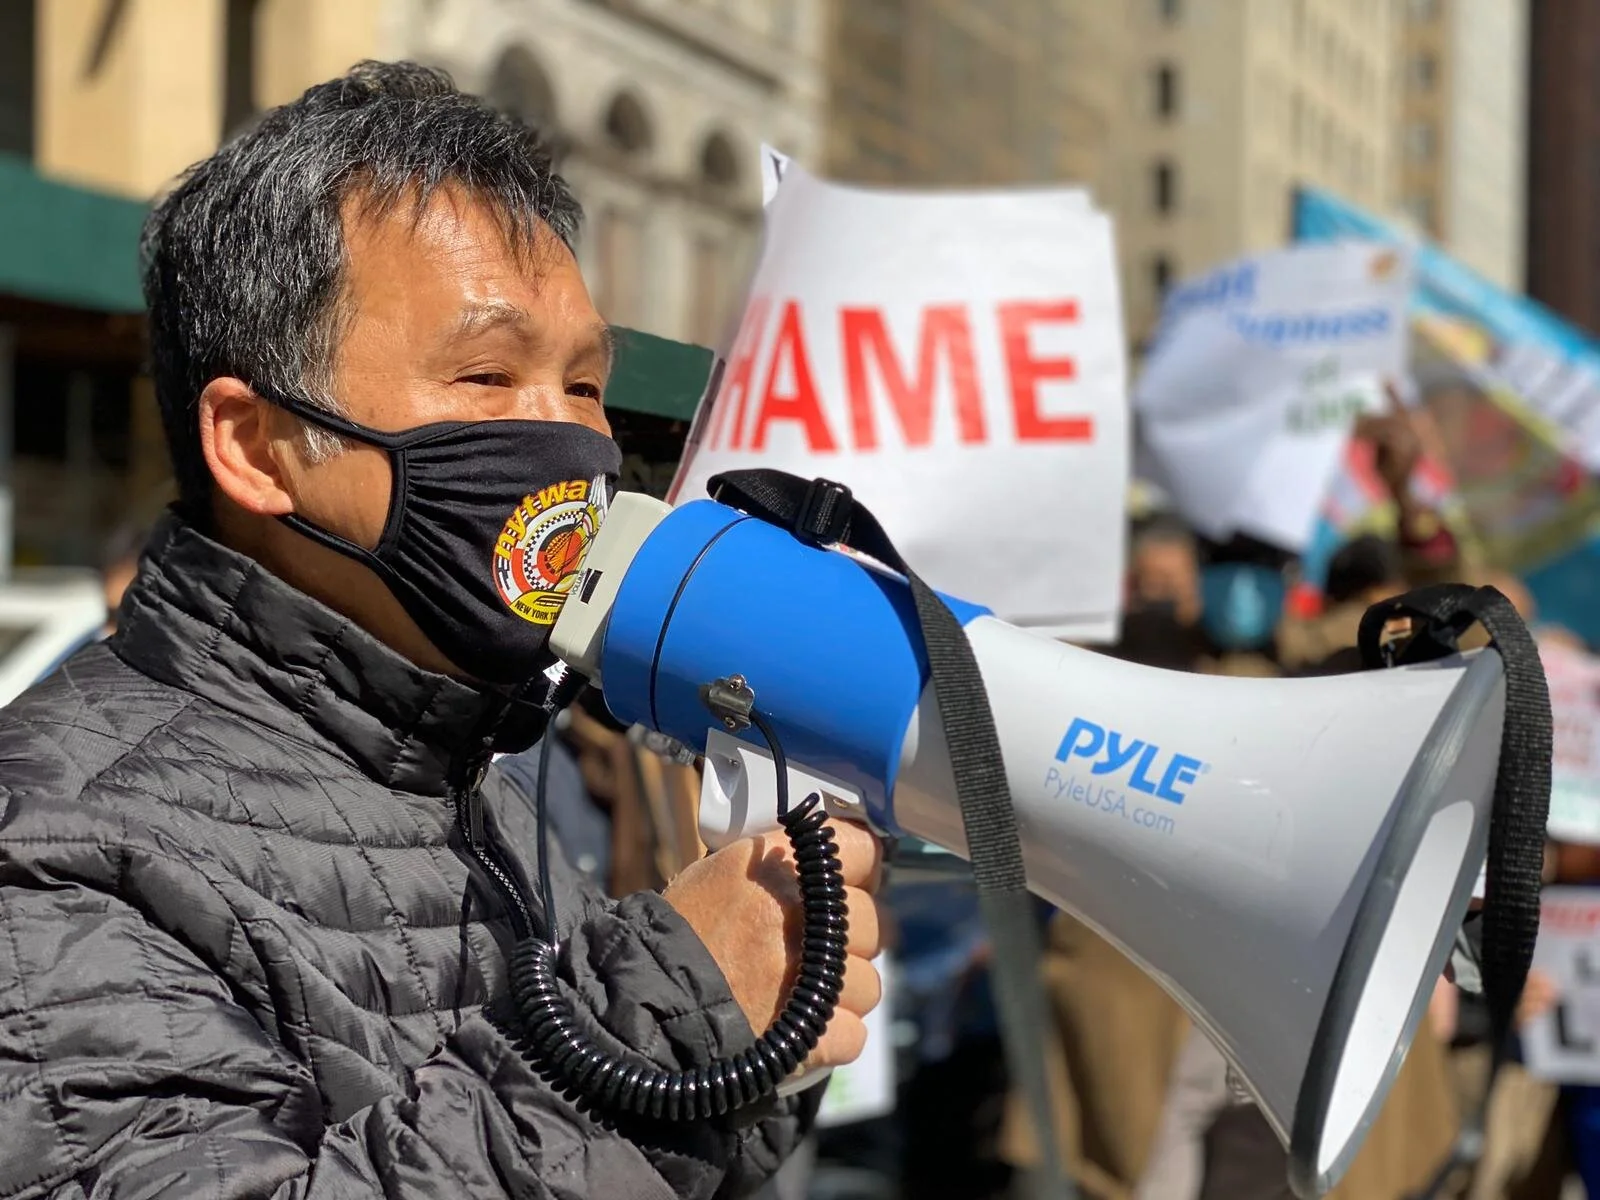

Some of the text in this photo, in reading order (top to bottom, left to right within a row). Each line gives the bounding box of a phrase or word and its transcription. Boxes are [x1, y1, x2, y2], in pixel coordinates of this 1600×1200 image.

[496, 480, 588, 560] nytwa
[515, 601, 531, 615] NEW
[532, 609, 549, 620] YORK
[571, 569, 586, 595] VOLUME
[1055, 717, 1202, 804] PYLE
[1044, 767, 1175, 835] PyleUSA.com
